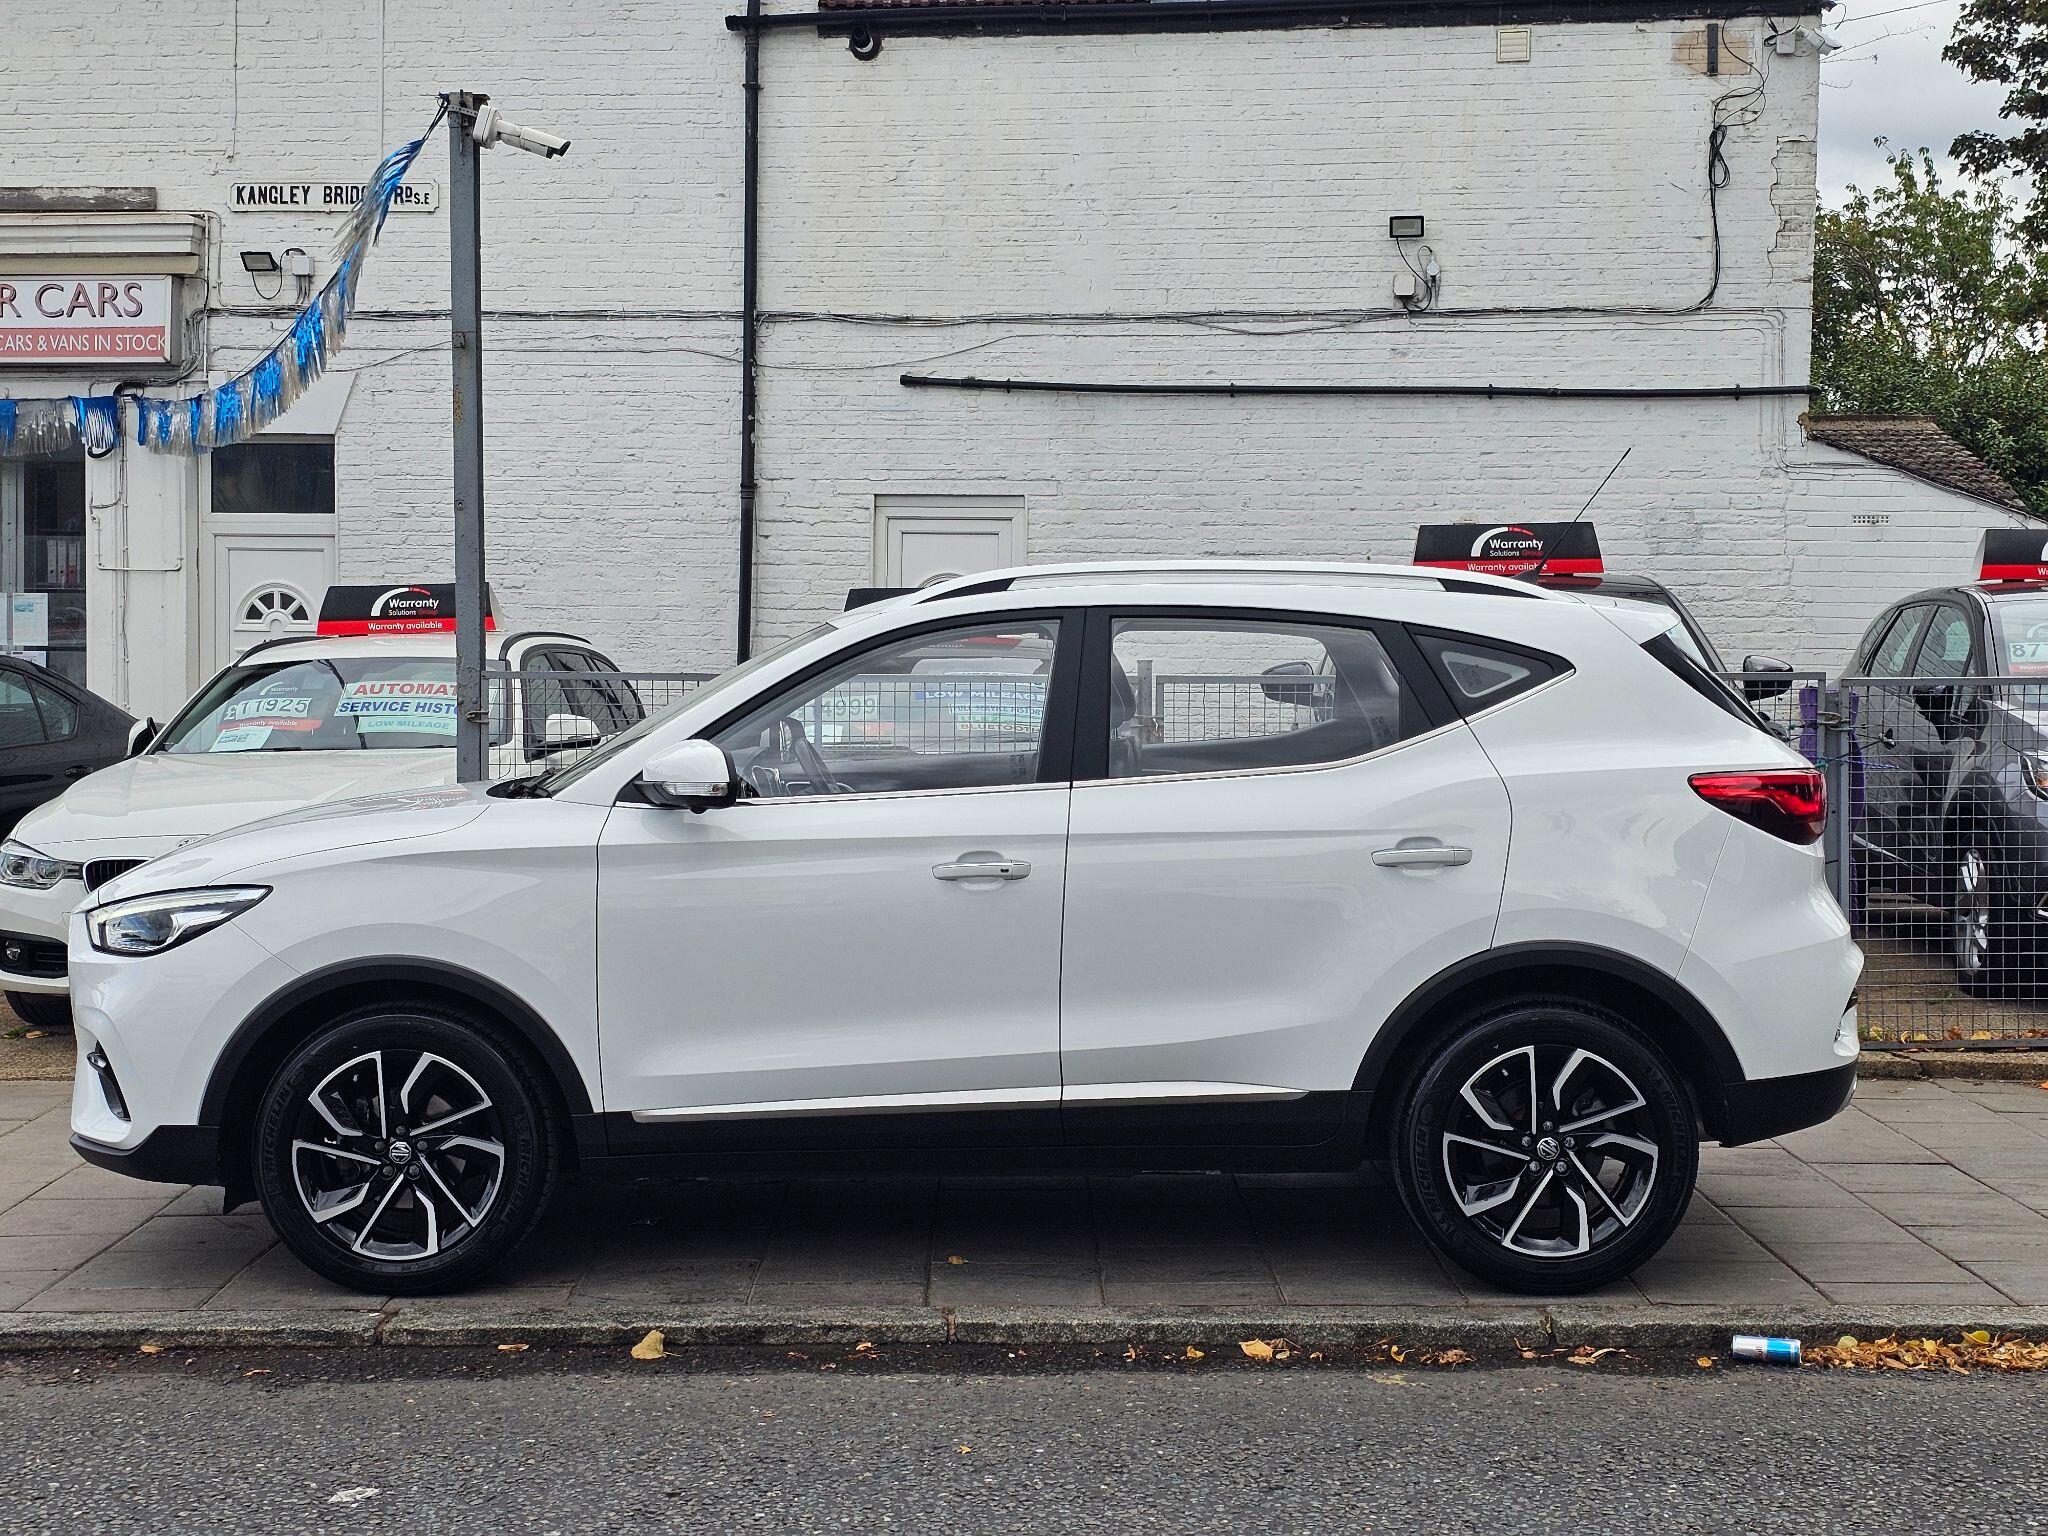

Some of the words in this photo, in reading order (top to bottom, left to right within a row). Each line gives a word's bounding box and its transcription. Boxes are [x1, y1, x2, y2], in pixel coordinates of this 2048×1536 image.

[236, 185, 310, 205] KANGLEY
[323, 185, 368, 205] BRID
[34, 282, 143, 318] CARS
[37, 335, 47, 351] &
[49, 335, 90, 351] VANS
[94, 335, 111, 351] IN
[115, 334, 165, 351] STOCK
[1489, 538, 1544, 550] Warranty
[1489, 549, 1520, 557] Solutions
[1467, 563, 1506, 572] Warranty
[388, 598, 439, 610] Warranty
[368, 622, 404, 632] Warranty
[406, 620, 443, 630] available
[2012, 643, 2048, 658] 87
[925, 691, 964, 699] LOW
[971, 691, 1045, 701] MILEAGE
[339, 701, 410, 713] SERVICE
[368, 720, 393, 728] LOW
[397, 720, 449, 730] MILEAGE
